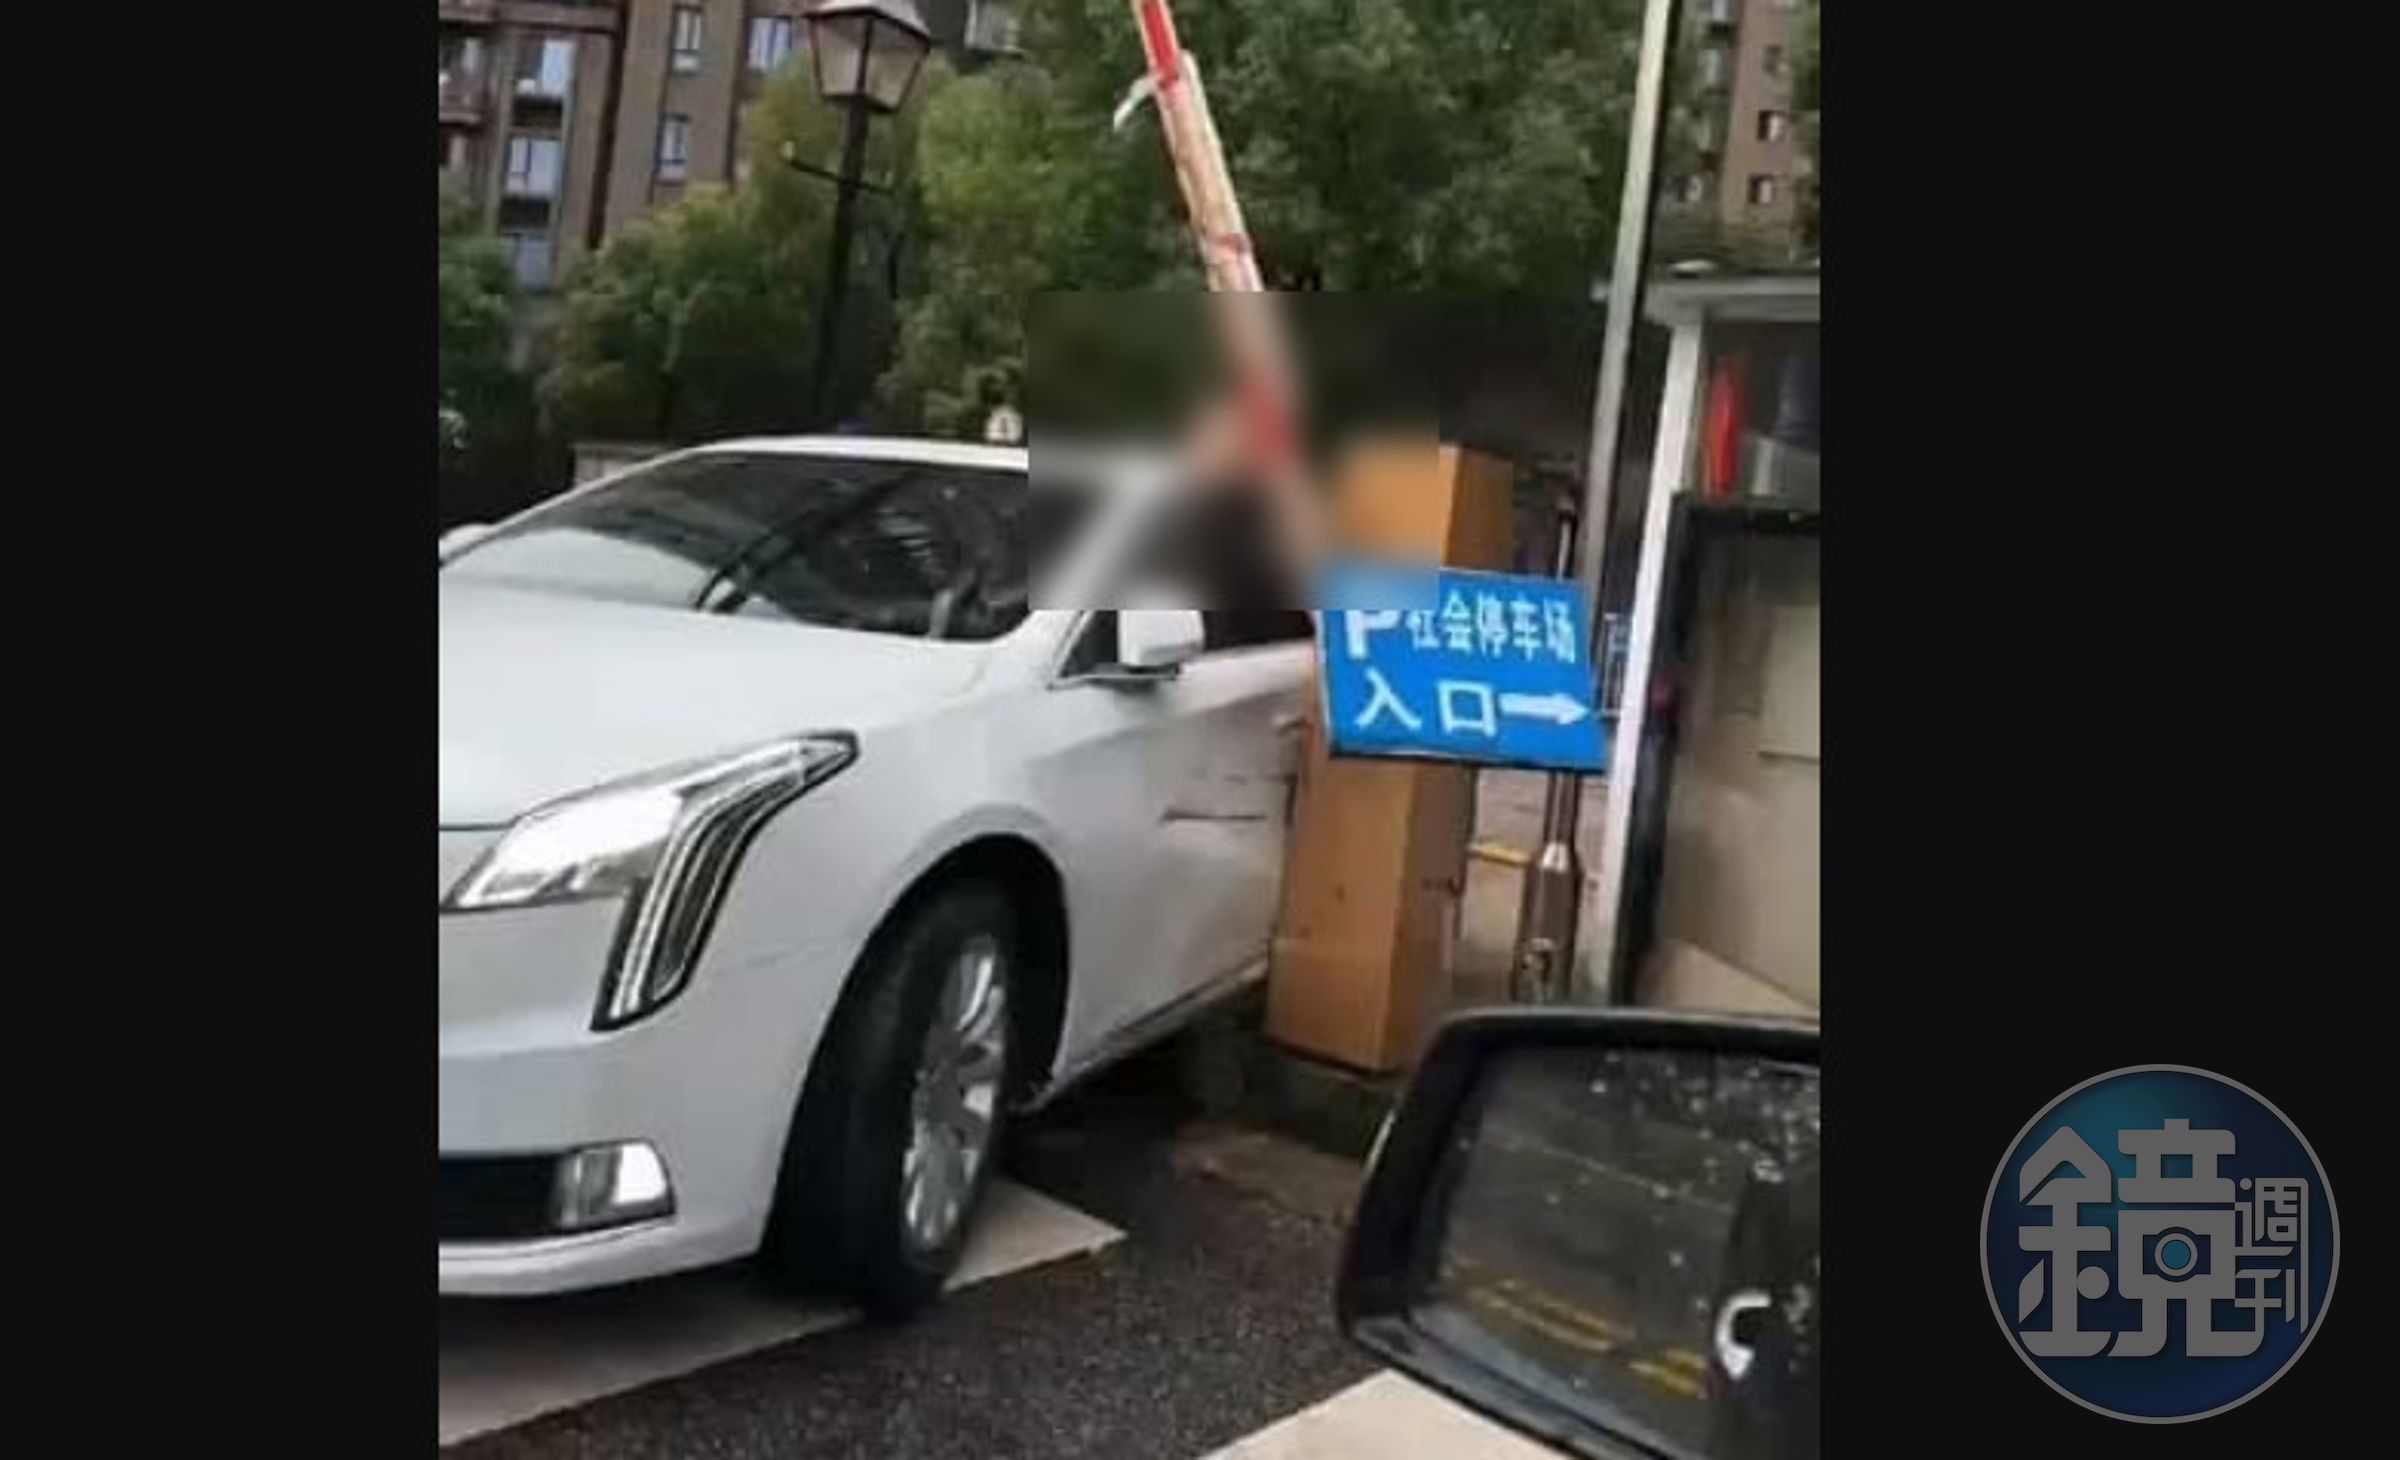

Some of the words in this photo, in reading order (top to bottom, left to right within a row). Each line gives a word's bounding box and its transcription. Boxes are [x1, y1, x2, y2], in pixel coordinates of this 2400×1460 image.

[1344, 609, 1400, 659] P
[1405, 588, 1576, 663] 社会停车场
[1355, 667, 1497, 737] 入口
